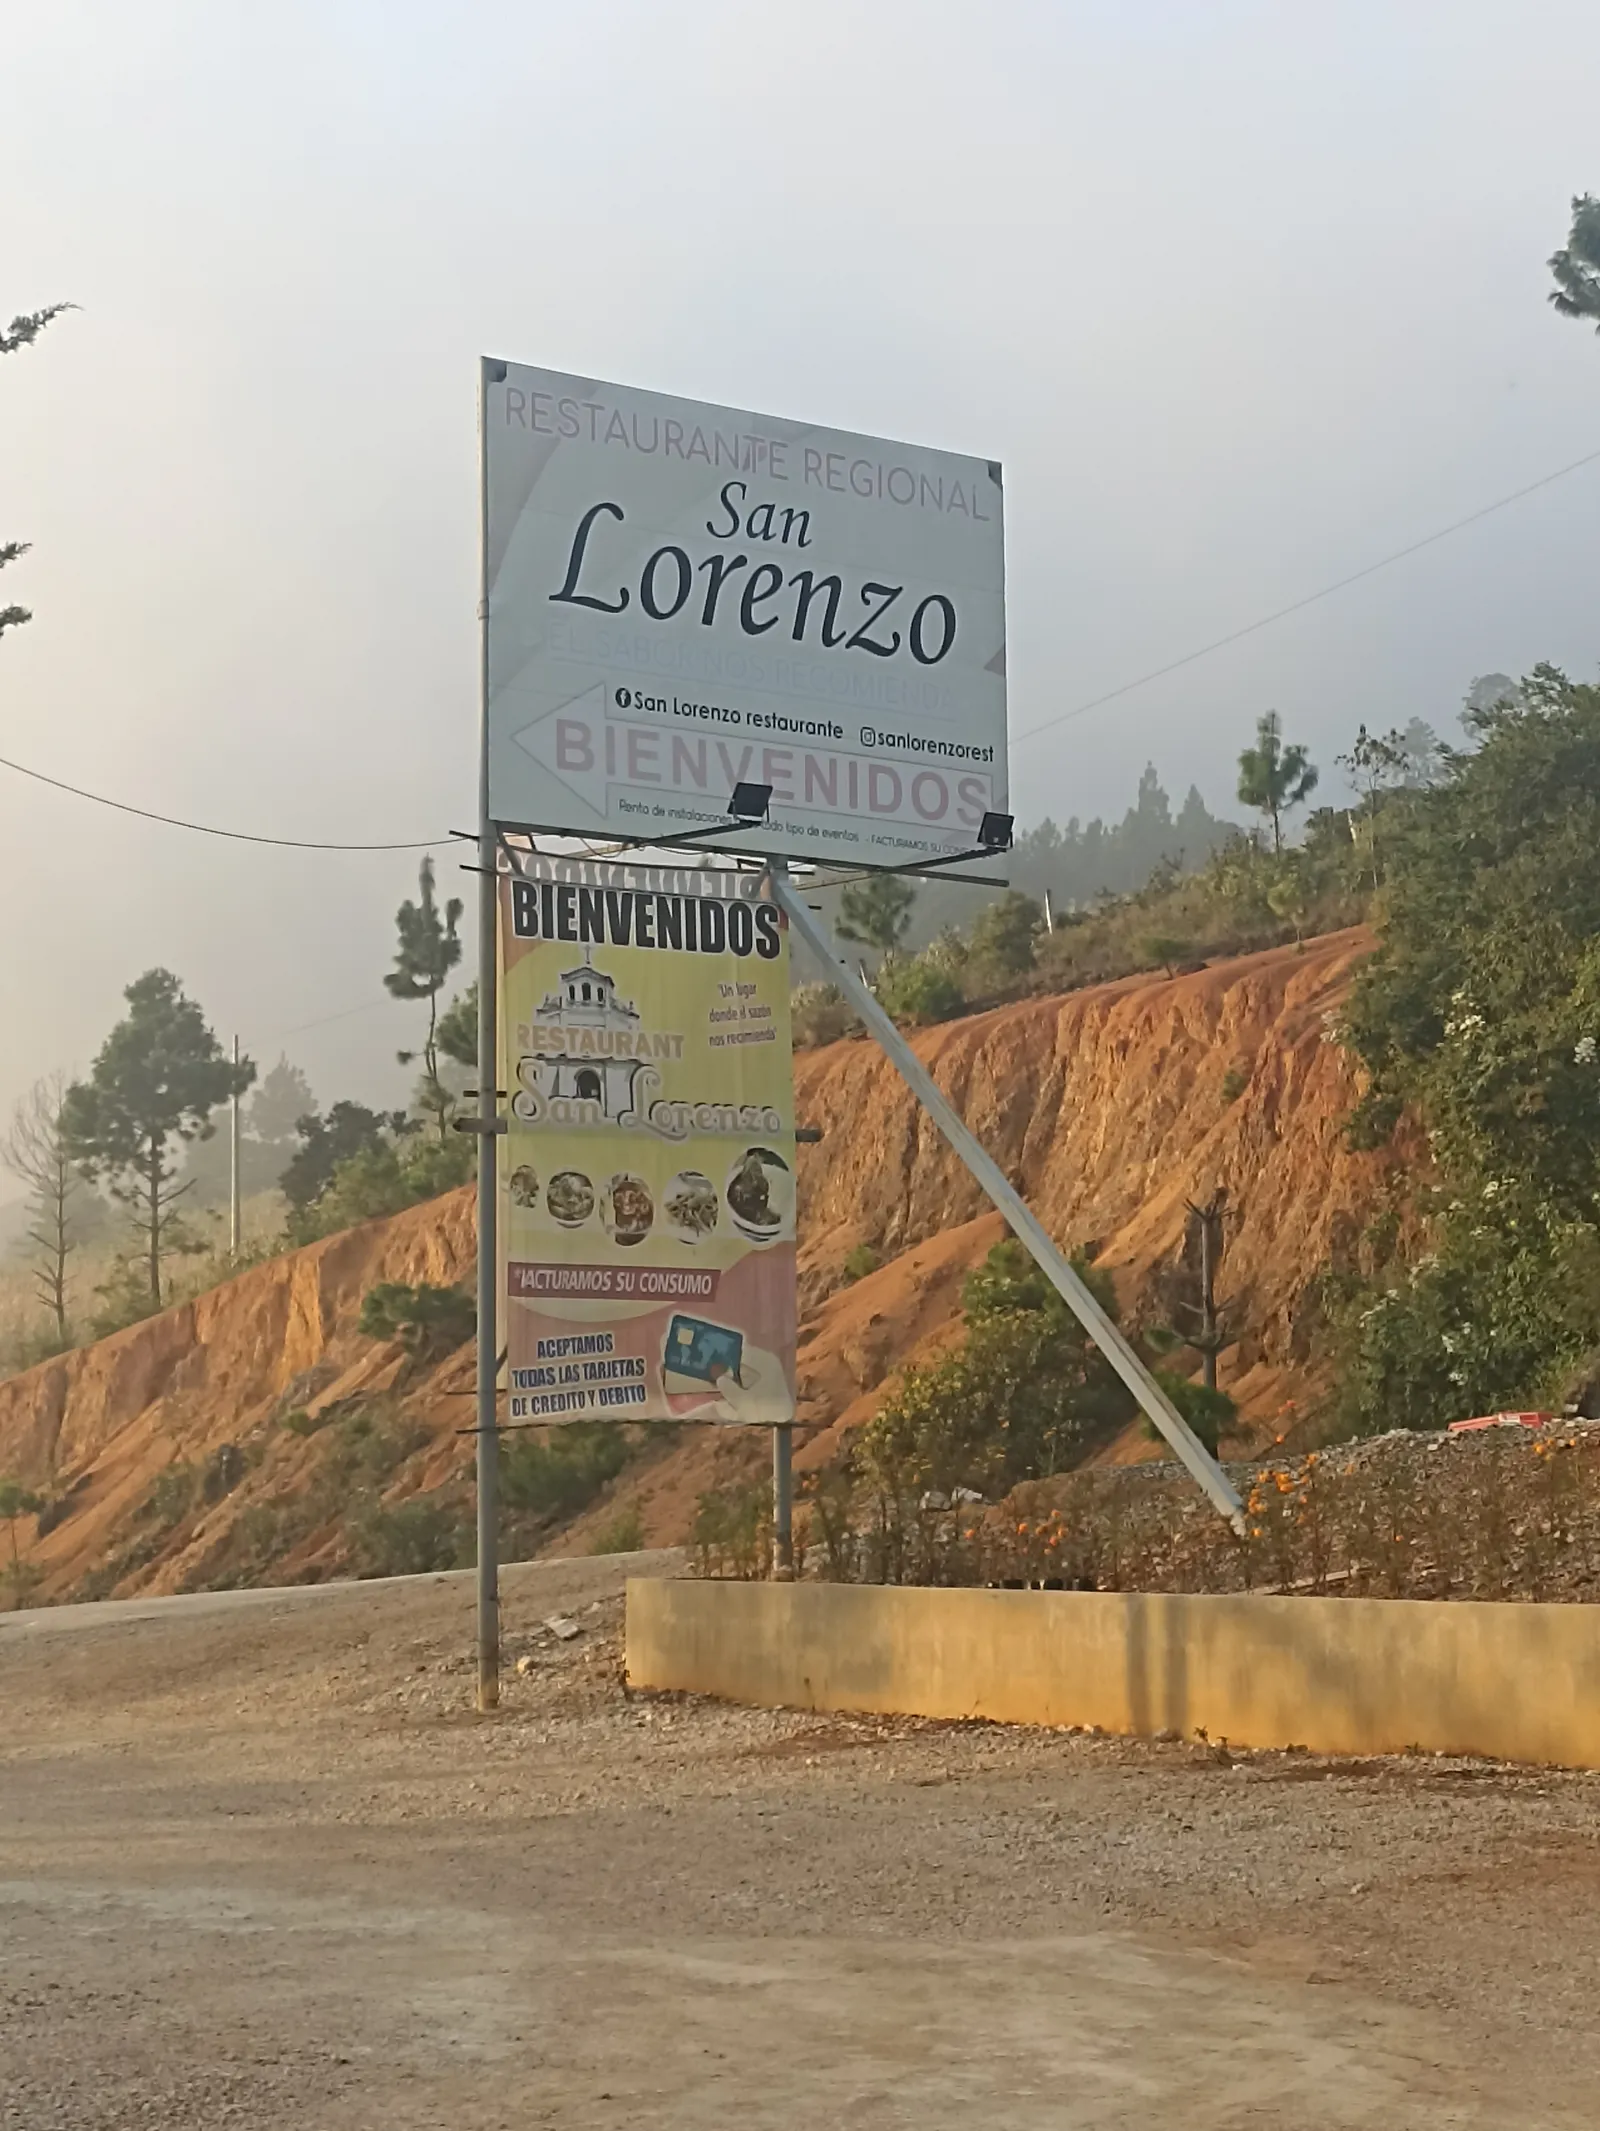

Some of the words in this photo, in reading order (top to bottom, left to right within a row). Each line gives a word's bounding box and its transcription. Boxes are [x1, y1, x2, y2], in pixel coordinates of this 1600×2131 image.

[505, 386, 788, 481] RESTAURANTE
[804, 448, 991, 522] REGIONAL
[706, 481, 812, 548] San
[548, 502, 957, 665] Lorenzo
[596, 629, 694, 670] SABOR
[703, 646, 766, 683] NOS
[634, 691, 667, 713] San
[673, 697, 741, 724] Lorenzo
[746, 711, 844, 739] restaurante
[877, 731, 994, 763] sanlorenzorest
[555, 718, 990, 827] BIENVENIDOS
[652, 804, 666, 817] de
[512, 880, 781, 960] BIENVENIDOS
[517, 1024, 685, 1058] RESTAURANT
[512, 1056, 603, 1123] San
[616, 1063, 781, 1141] Lorenzo
[615, 1271, 636, 1292] SU
[639, 1273, 712, 1295] CONSUMO
[537, 1333, 614, 1358] ACEPTAMOS
[512, 1366, 556, 1389] TODAS
[558, 1364, 580, 1384] LAS
[582, 1358, 645, 1380] TARJETAS
[512, 1397, 528, 1416] DE
[531, 1391, 586, 1415] CREDITO
[587, 1390, 596, 1407] Y
[599, 1385, 647, 1406] DEBITO
